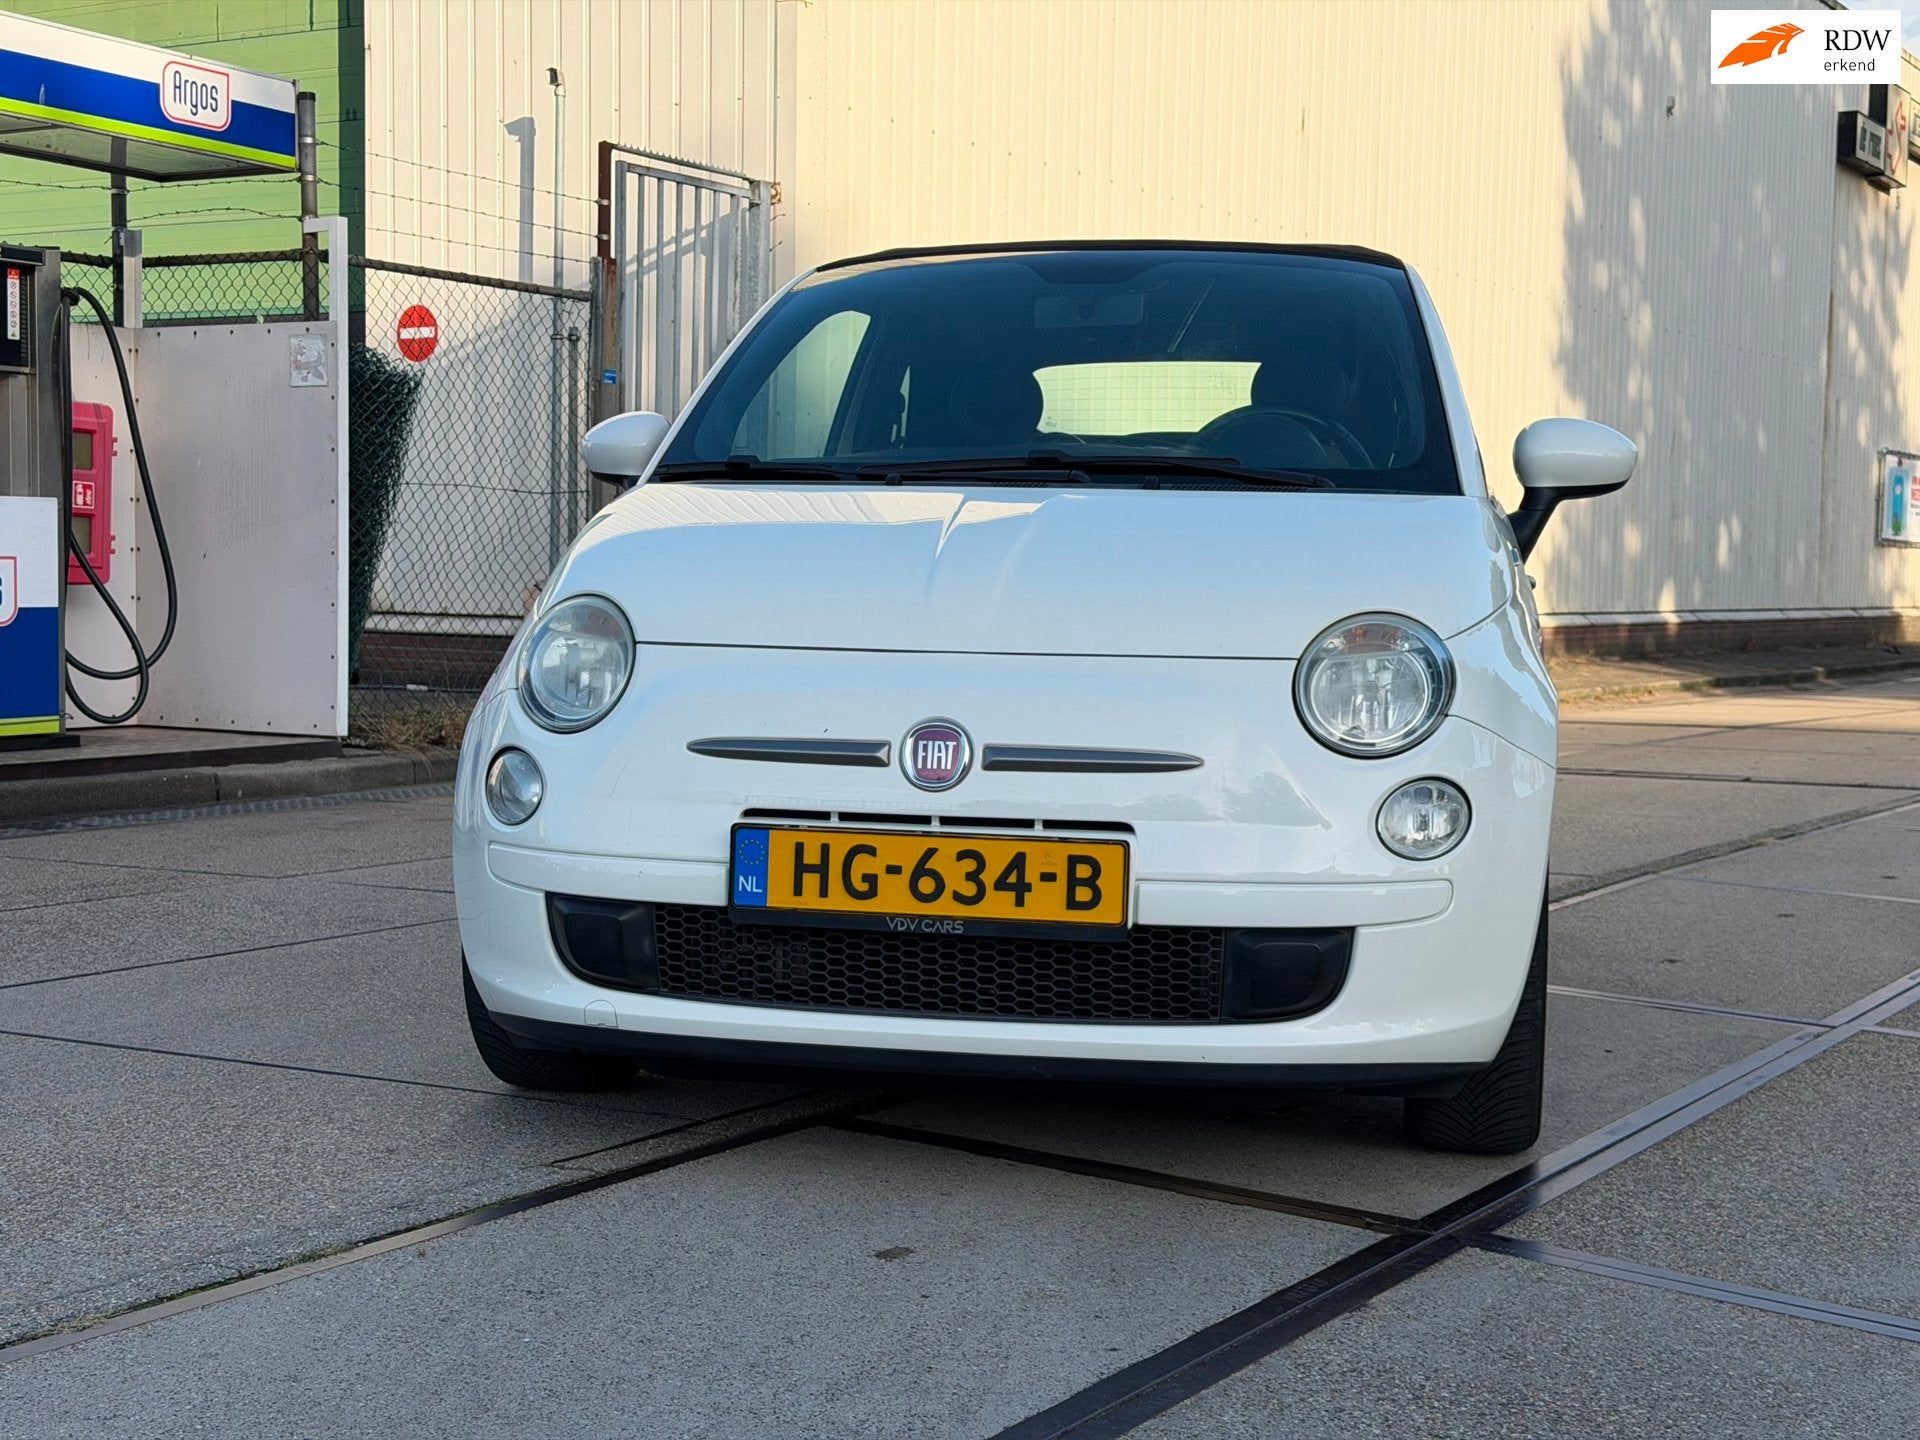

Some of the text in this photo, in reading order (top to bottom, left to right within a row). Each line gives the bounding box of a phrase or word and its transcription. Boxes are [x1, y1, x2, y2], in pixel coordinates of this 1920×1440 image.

[173, 70, 219, 116] Argos
[916, 740, 957, 770] FIAT
[738, 875, 763, 893] NL
[792, 841, 1103, 912] HG-634-B
[885, 916, 964, 934] VDV CARS
